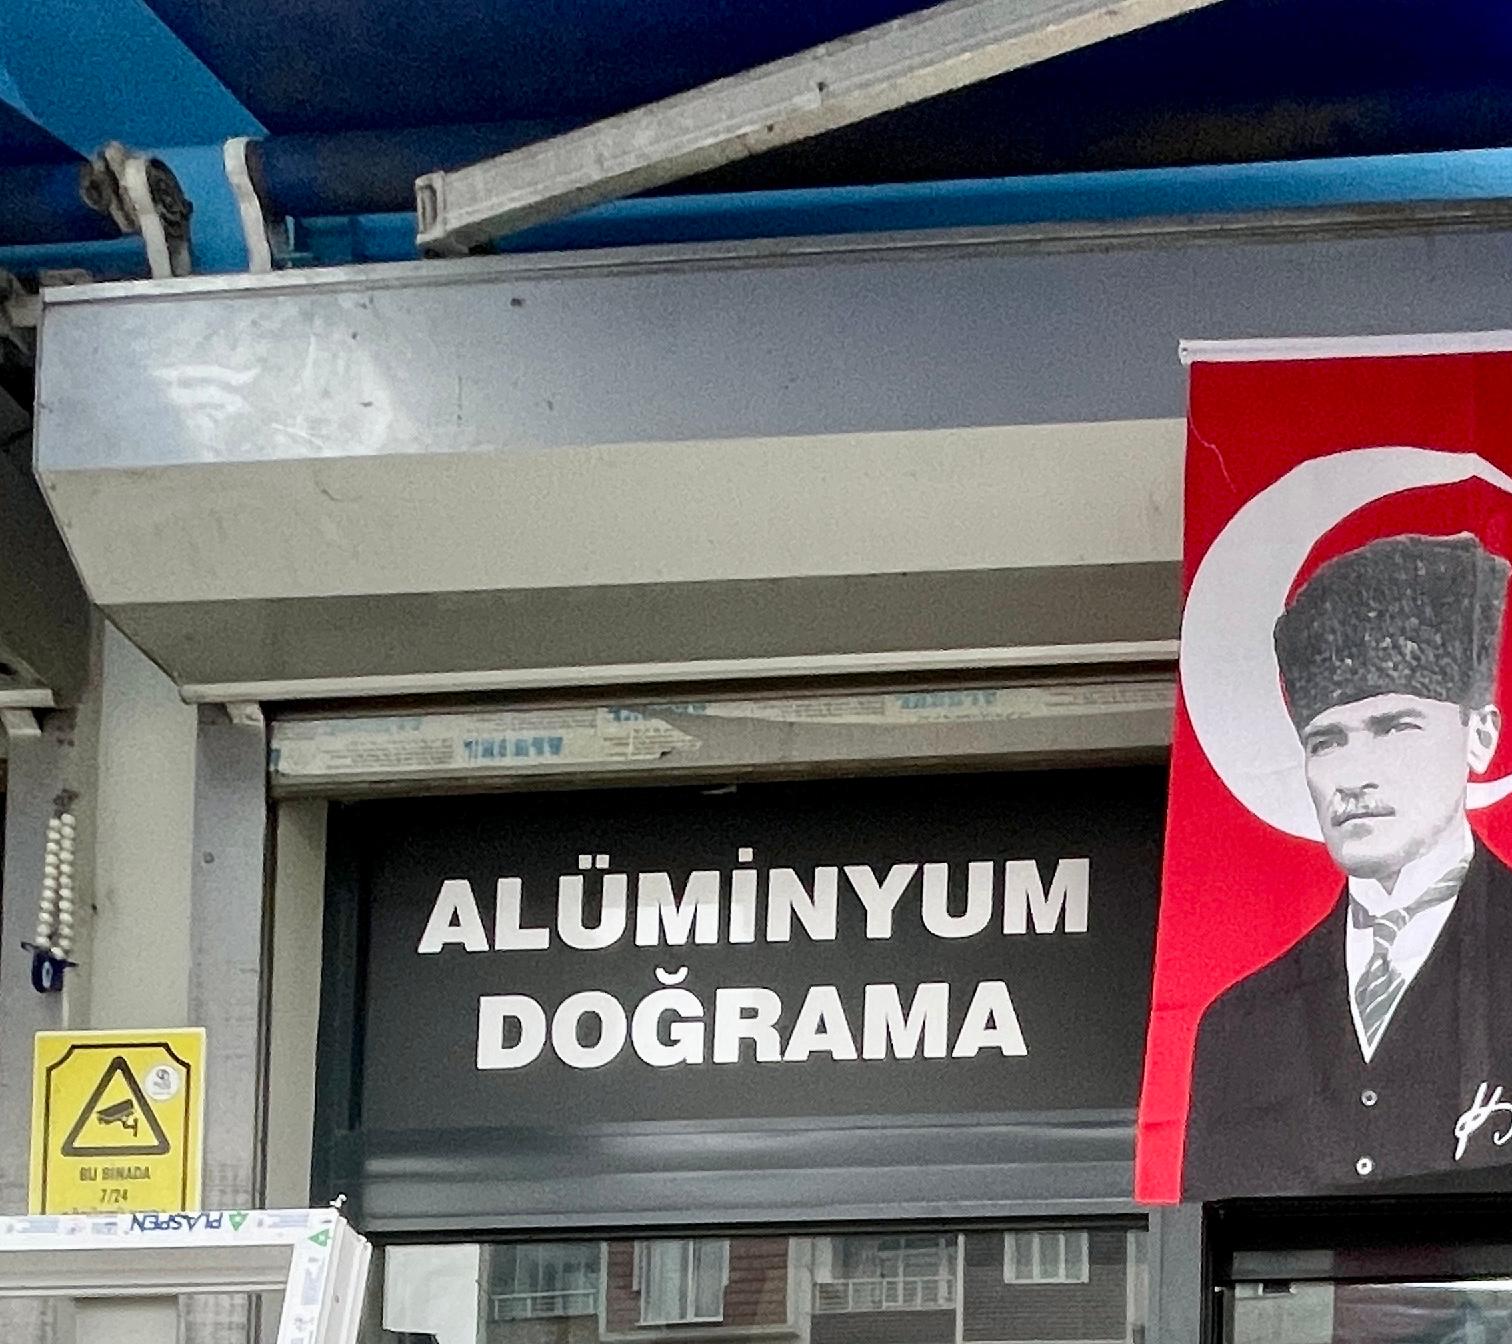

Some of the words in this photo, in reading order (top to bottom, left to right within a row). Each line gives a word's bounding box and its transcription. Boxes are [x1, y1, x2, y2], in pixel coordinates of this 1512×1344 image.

[418, 848, 1089, 953] ALÜMİNYUM
[477, 967, 1027, 1069] DOĞRAMA
[79, 1166, 98, 1182] BU
[130, 1212, 223, 1232] PLASPEN
